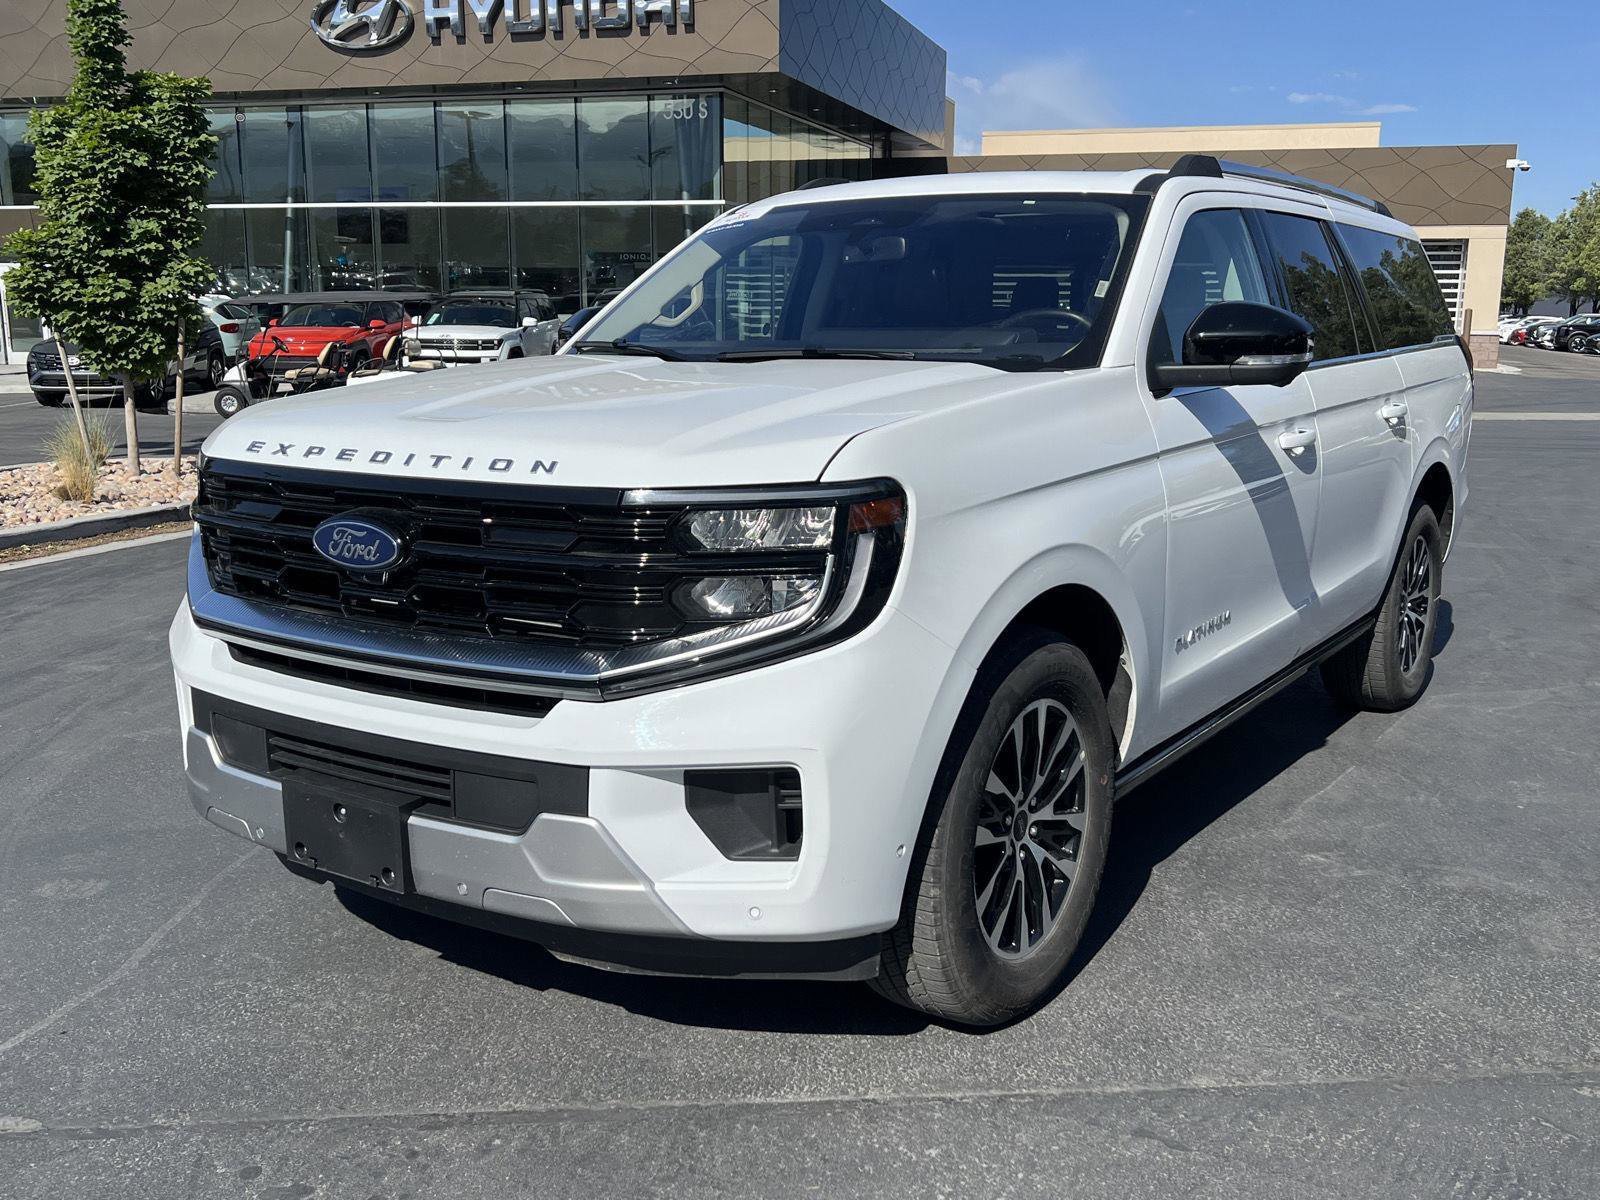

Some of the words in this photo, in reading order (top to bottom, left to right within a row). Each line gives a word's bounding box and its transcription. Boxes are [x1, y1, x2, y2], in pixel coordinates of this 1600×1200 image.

[424, 0, 695, 45] HYUNDAI
[698, 101, 708, 119] S
[246, 440, 560, 476] EXPEDITION
[327, 525, 381, 564] Ford
